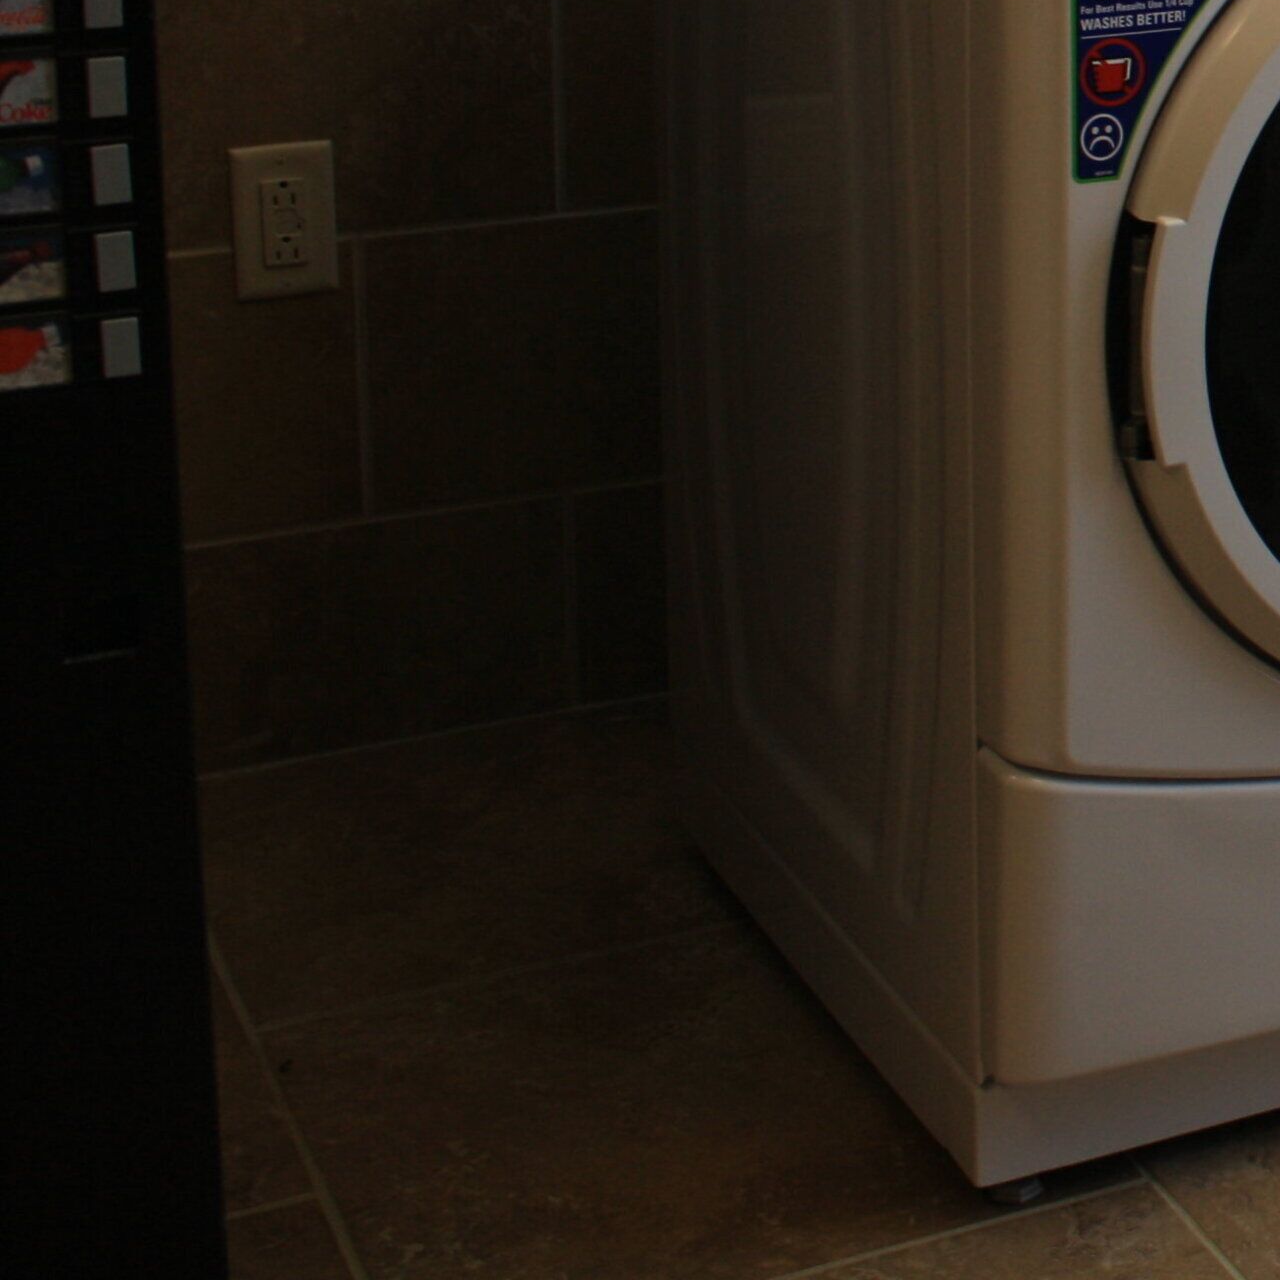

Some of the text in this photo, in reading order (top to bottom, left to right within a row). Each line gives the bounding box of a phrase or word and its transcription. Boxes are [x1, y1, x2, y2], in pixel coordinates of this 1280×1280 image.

[1080, 5, 1094, 15] For
[1095, 4, 1115, 14] Best
[1115, 1, 1146, 11] Results
[1147, 0, 1163, 9] Use
[1080, 9, 1186, 31] WASHES BETTER!
